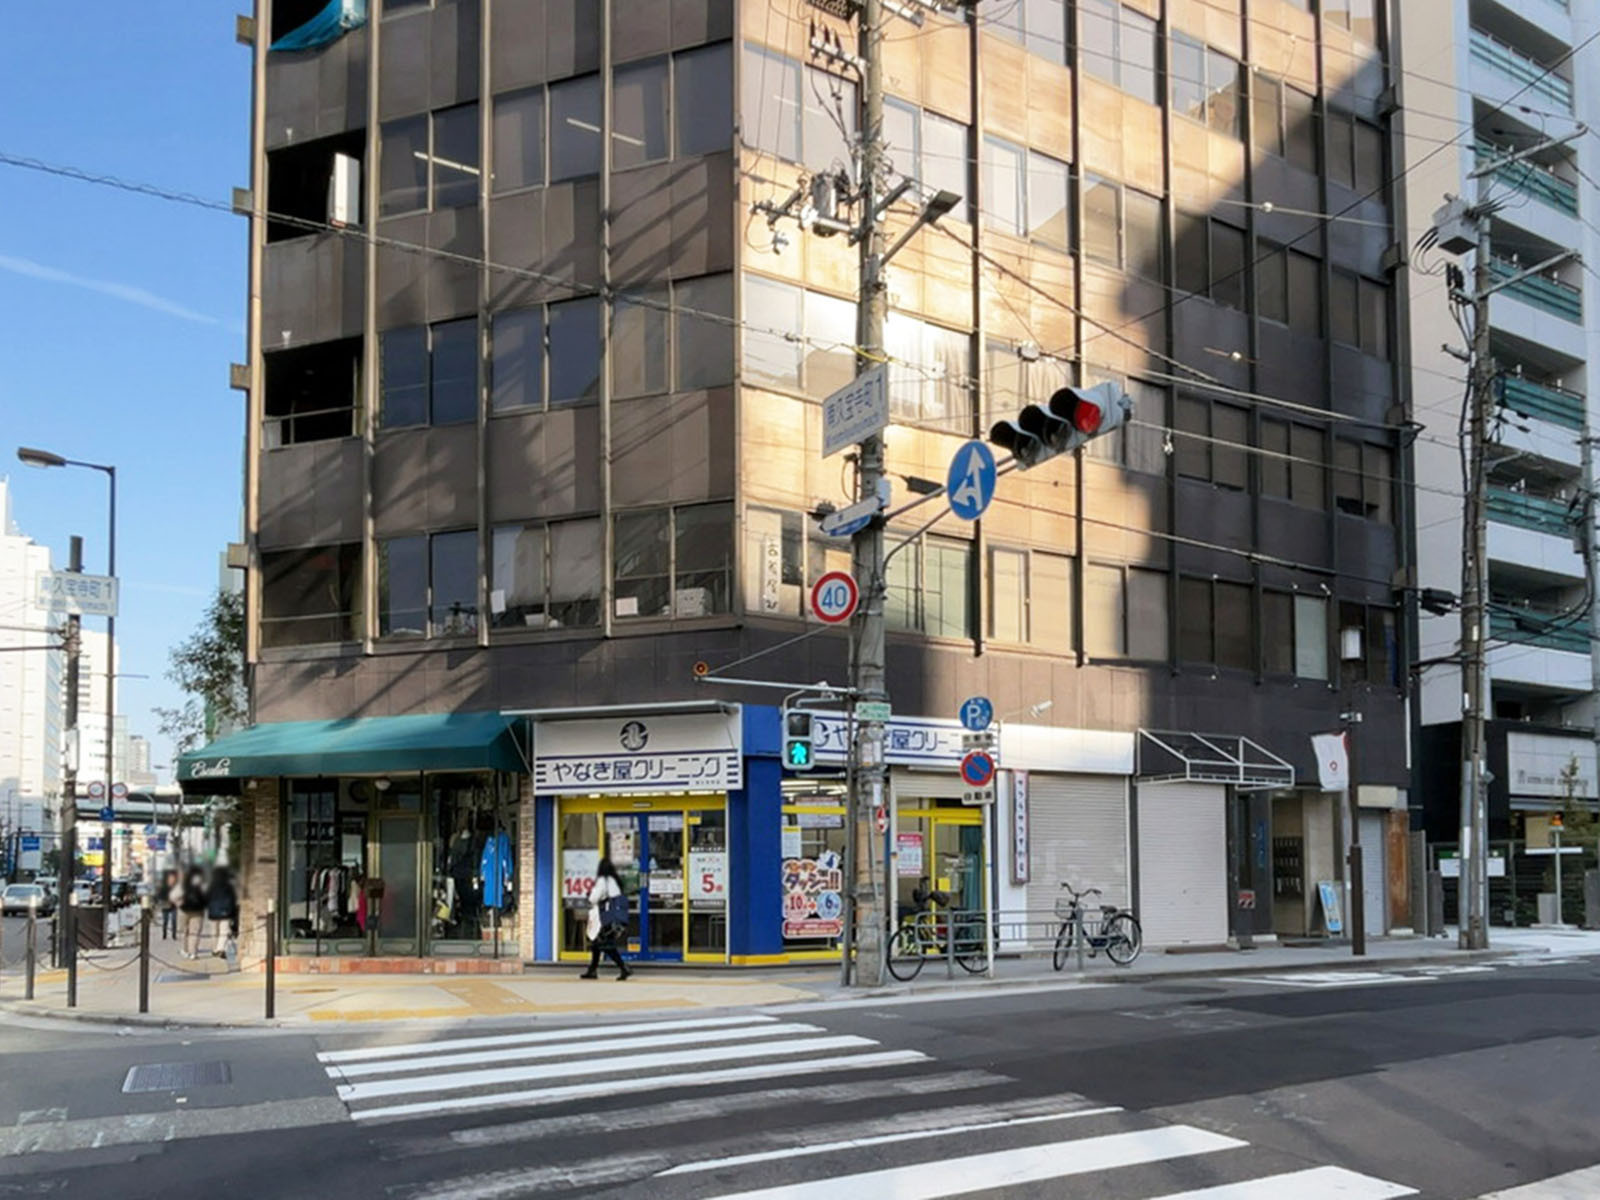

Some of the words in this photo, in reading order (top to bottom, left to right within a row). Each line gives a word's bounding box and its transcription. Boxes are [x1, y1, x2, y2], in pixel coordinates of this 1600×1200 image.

[822, 585, 848, 609] 40
[967, 705, 981, 728] P
[553, 758, 720, 781] やなぎ屋クリーニング
[565, 878, 595, 896] 149
[790, 895, 803, 910] 10
[825, 894, 833, 909] 6
